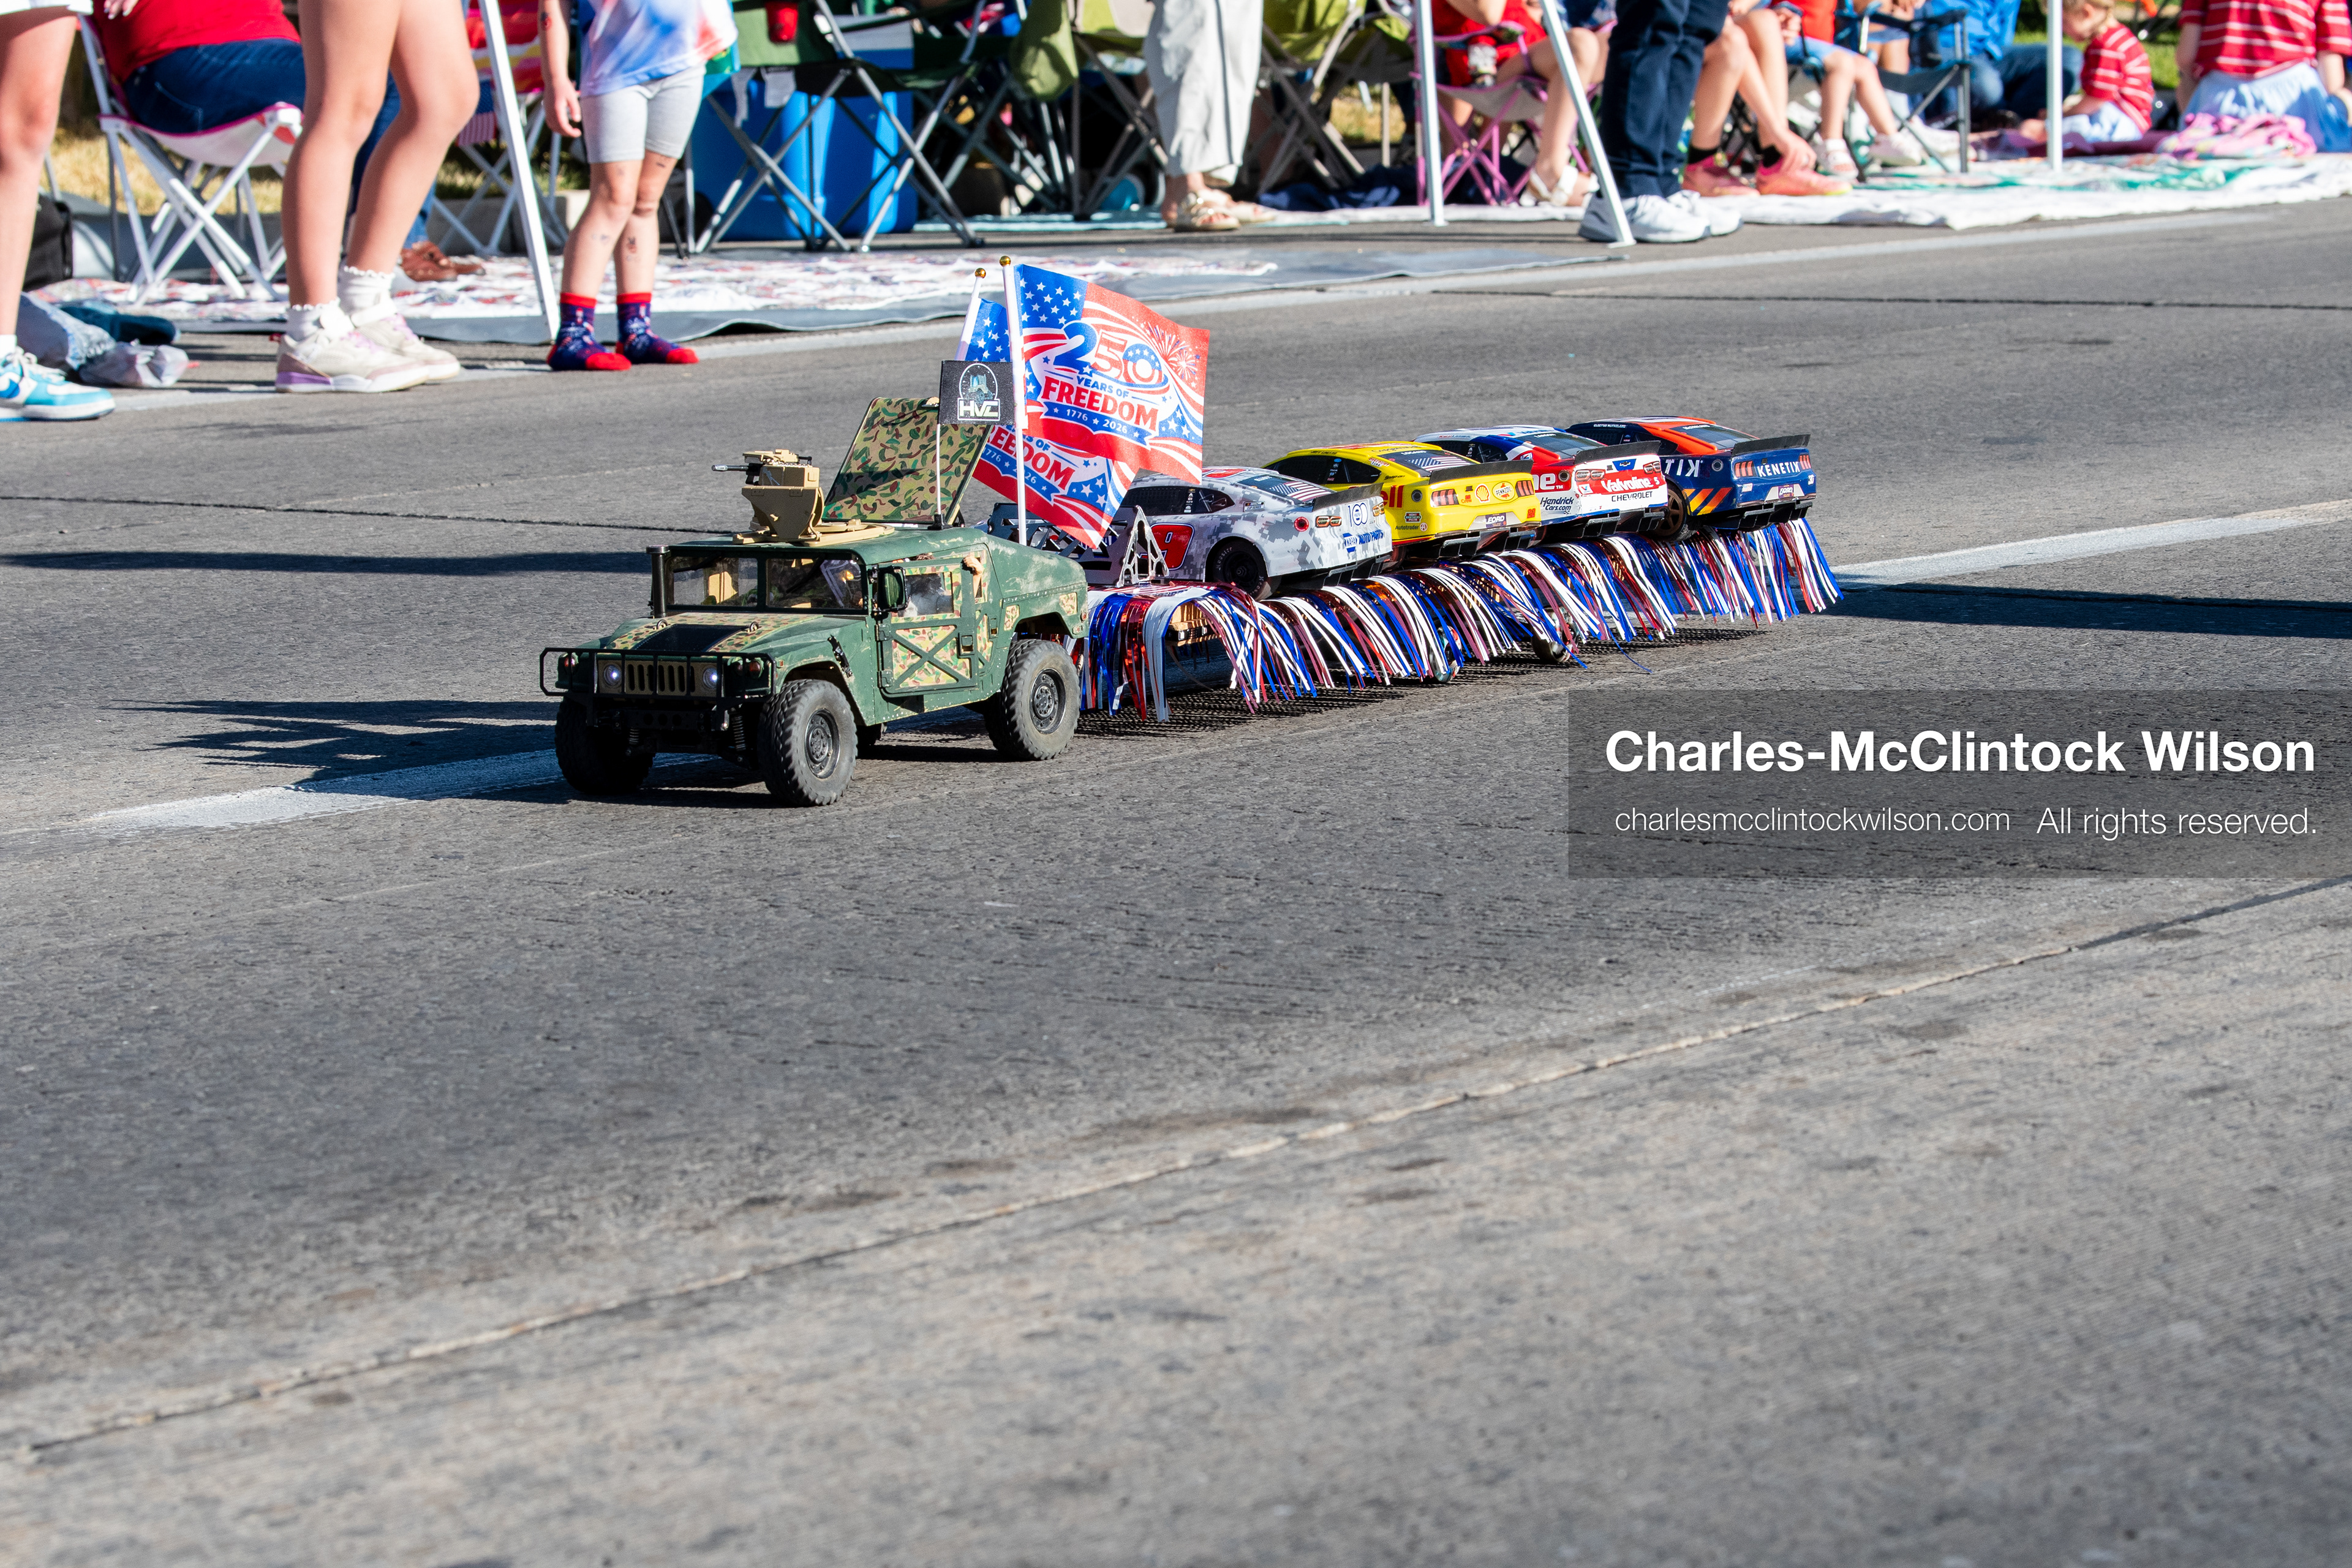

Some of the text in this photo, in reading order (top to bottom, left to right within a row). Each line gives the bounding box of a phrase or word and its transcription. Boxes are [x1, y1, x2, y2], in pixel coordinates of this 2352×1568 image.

[1053, 322, 1163, 383] 250
[1076, 375, 1129, 398] YEARS OF
[1041, 375, 1158, 431] FREEDOM
[1066, 409, 1128, 433] 1776 2026
[1036, 439, 1050, 451] OF
[1495, 486, 1512, 496] PENNZOIL
[1600, 477, 1660, 492] Valvoline 5
[1540, 497, 1574, 507] Hendrick
[1611, 491, 1653, 502] CHEVROLET
[1348, 503, 1368, 527] 100
[1487, 516, 1505, 524] FORD
[1527, 508, 1536, 519] 22
[1358, 533, 1371, 545] AUTO
[1370, 529, 1384, 541] PARTS
